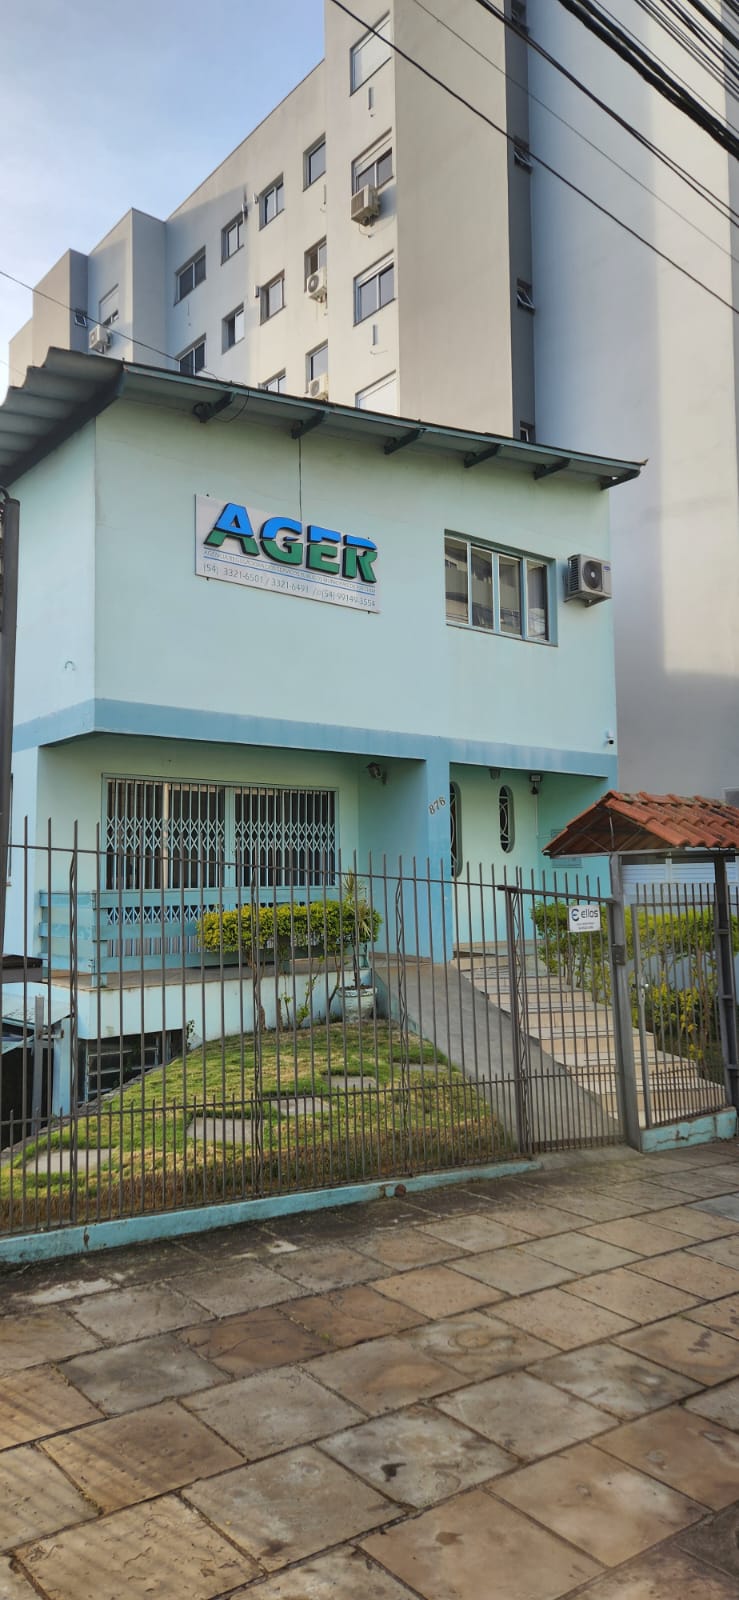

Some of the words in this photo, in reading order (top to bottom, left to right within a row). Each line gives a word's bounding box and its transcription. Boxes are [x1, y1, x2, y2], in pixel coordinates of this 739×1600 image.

[203, 502, 377, 584] AGER
[203, 563, 218, 576] (54)
[429, 796, 446, 815] 876
